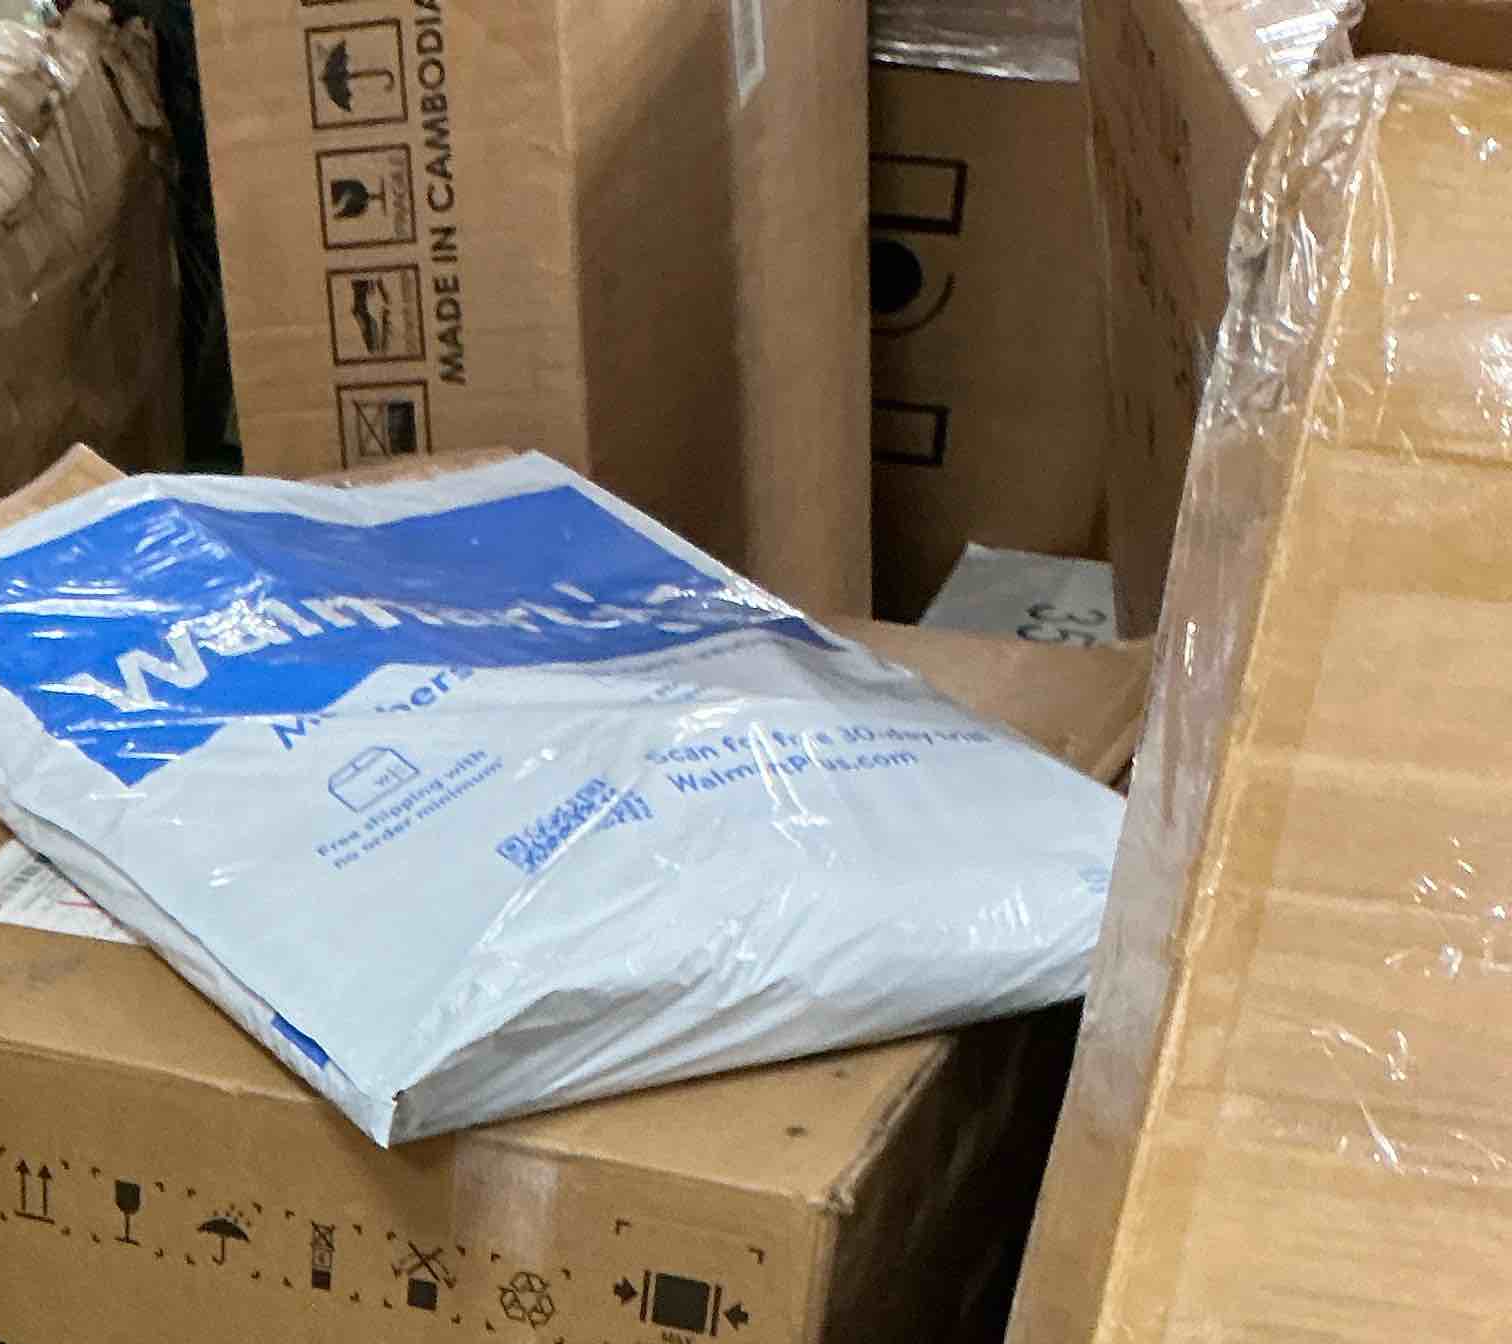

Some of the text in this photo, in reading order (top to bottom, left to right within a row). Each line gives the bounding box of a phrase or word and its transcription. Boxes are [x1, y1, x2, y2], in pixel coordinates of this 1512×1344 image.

[415, 0, 467, 386] MADE IN CAMBODIA
